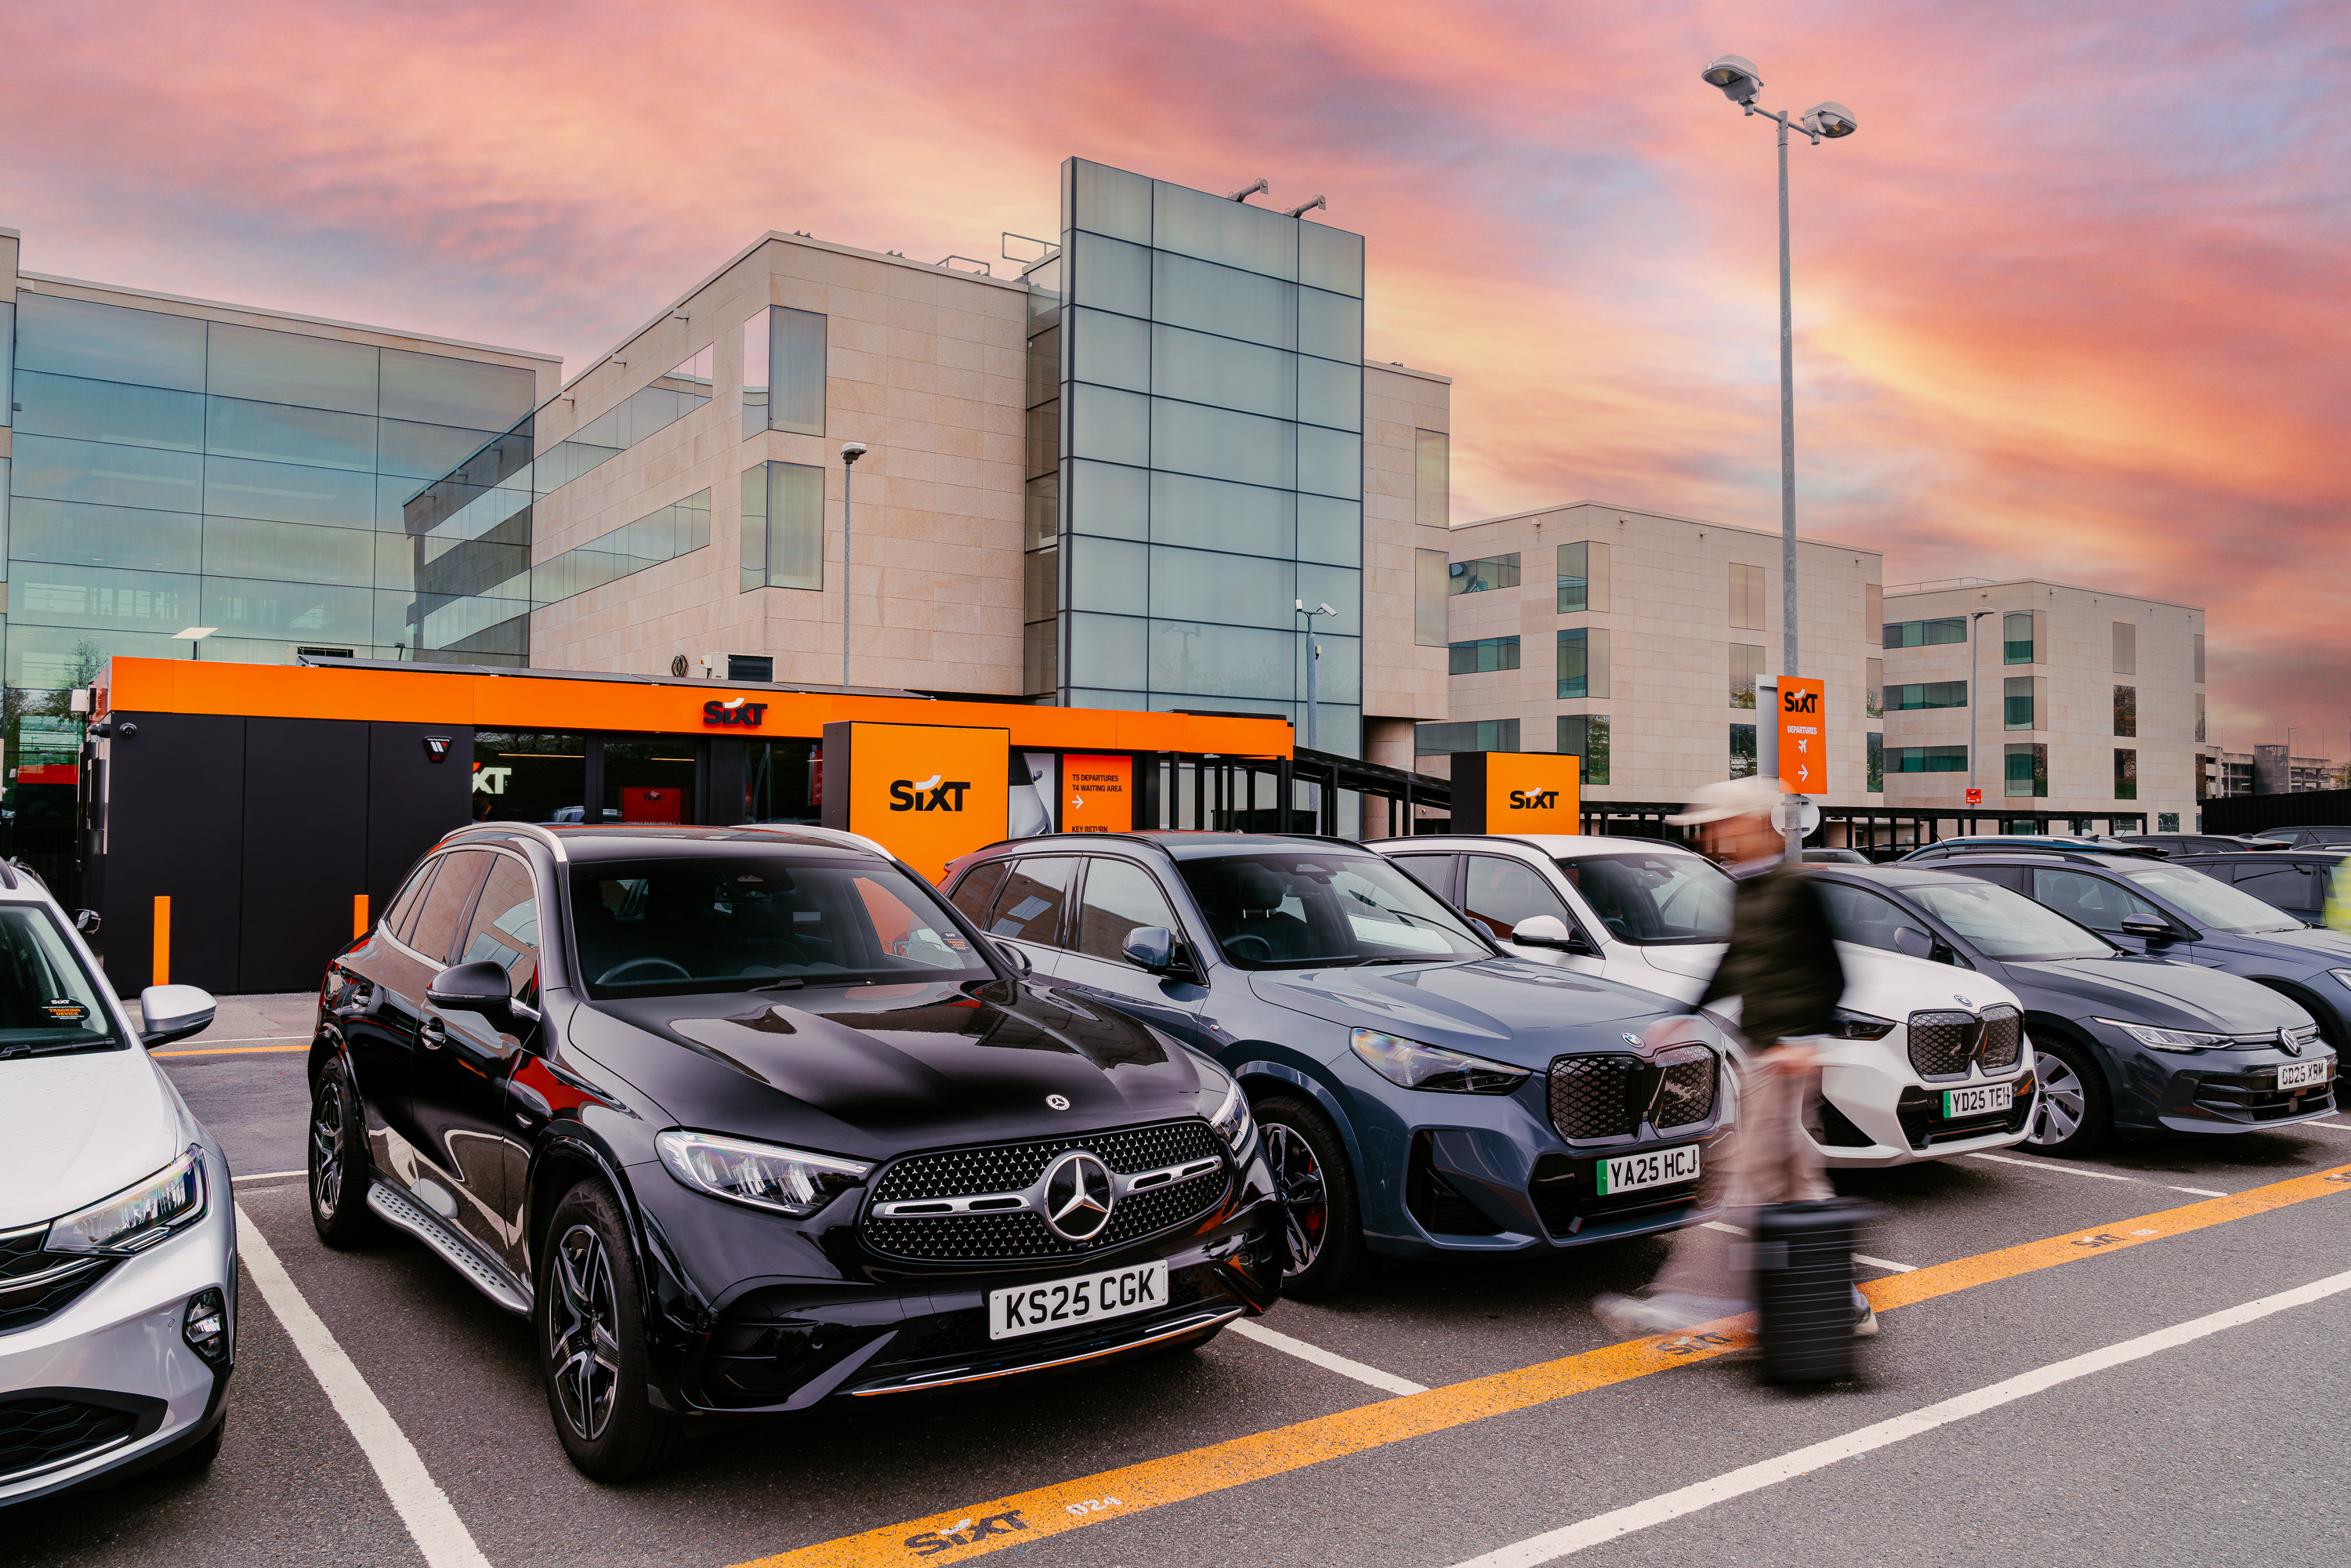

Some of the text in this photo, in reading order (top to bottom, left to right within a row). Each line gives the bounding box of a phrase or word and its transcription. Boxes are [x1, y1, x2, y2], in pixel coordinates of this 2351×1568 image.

[702, 697, 768, 726] SIXT
[1784, 688, 1818, 714] SIXT
[1787, 725, 1817, 735] DEPARTURES
[889, 776, 971, 812] SIXT
[1509, 787, 1559, 809] SIXT
[1953, 1085, 2009, 1113] YD25 TEH
[1610, 1149, 1697, 1188] YA25 HCJ
[1006, 1280, 1090, 1330] KS25
[1099, 1267, 1155, 1311] CGK
